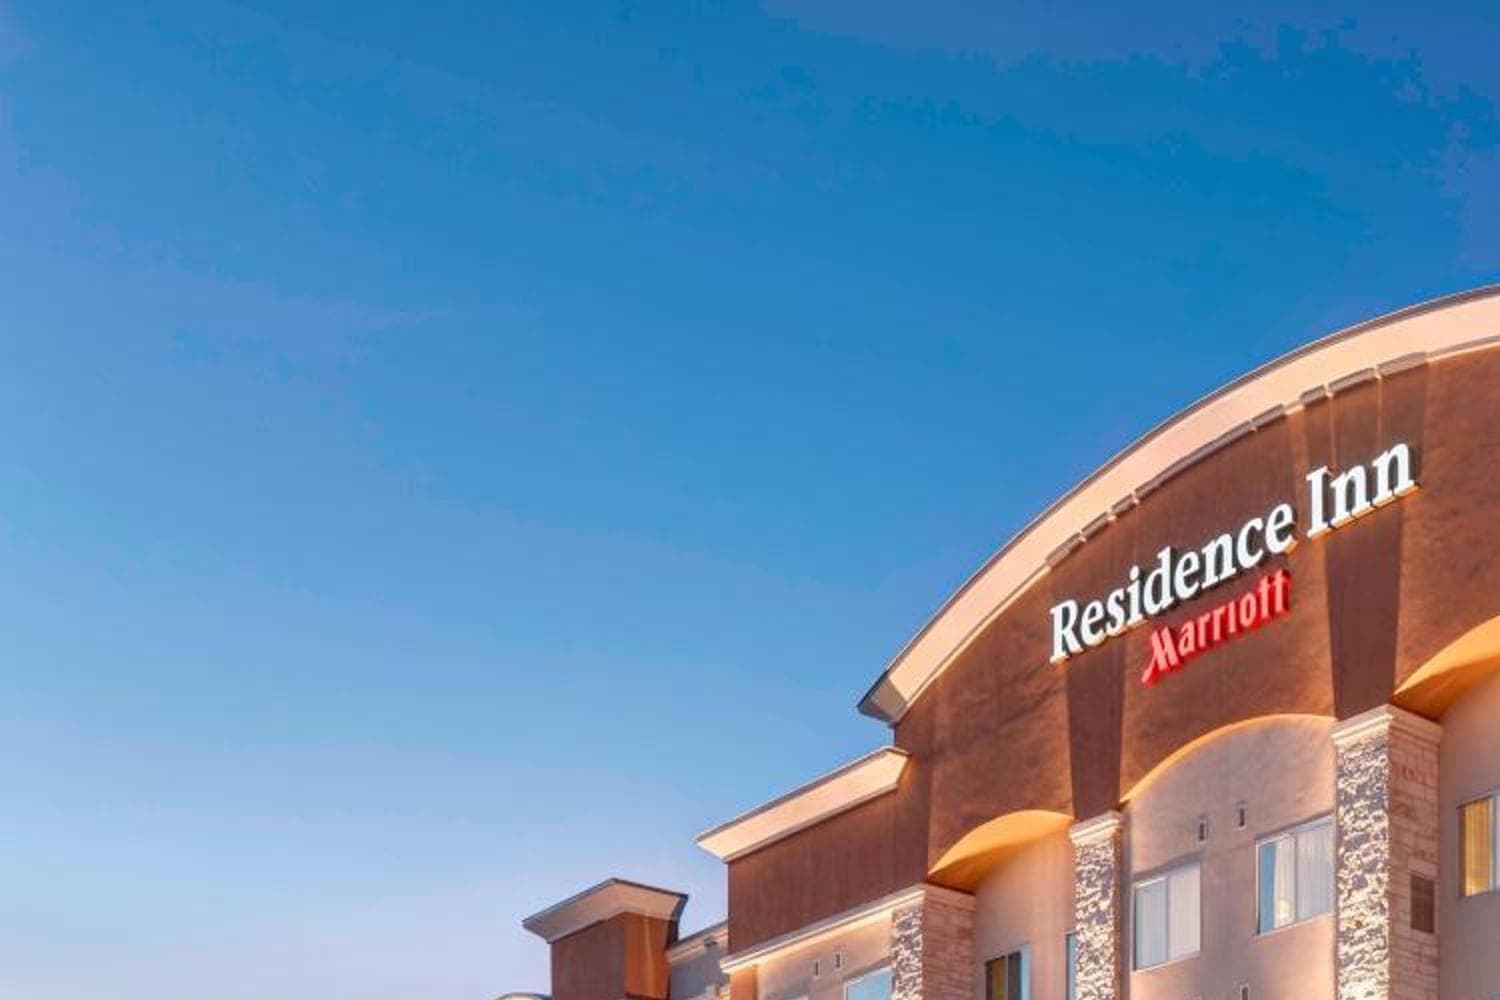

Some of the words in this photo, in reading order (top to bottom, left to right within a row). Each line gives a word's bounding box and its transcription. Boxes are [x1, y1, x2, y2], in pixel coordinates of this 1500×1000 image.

[1049, 502, 1297, 663] Residence
[1305, 442, 1417, 538] Inn
[1140, 568, 1291, 688] Marriott
